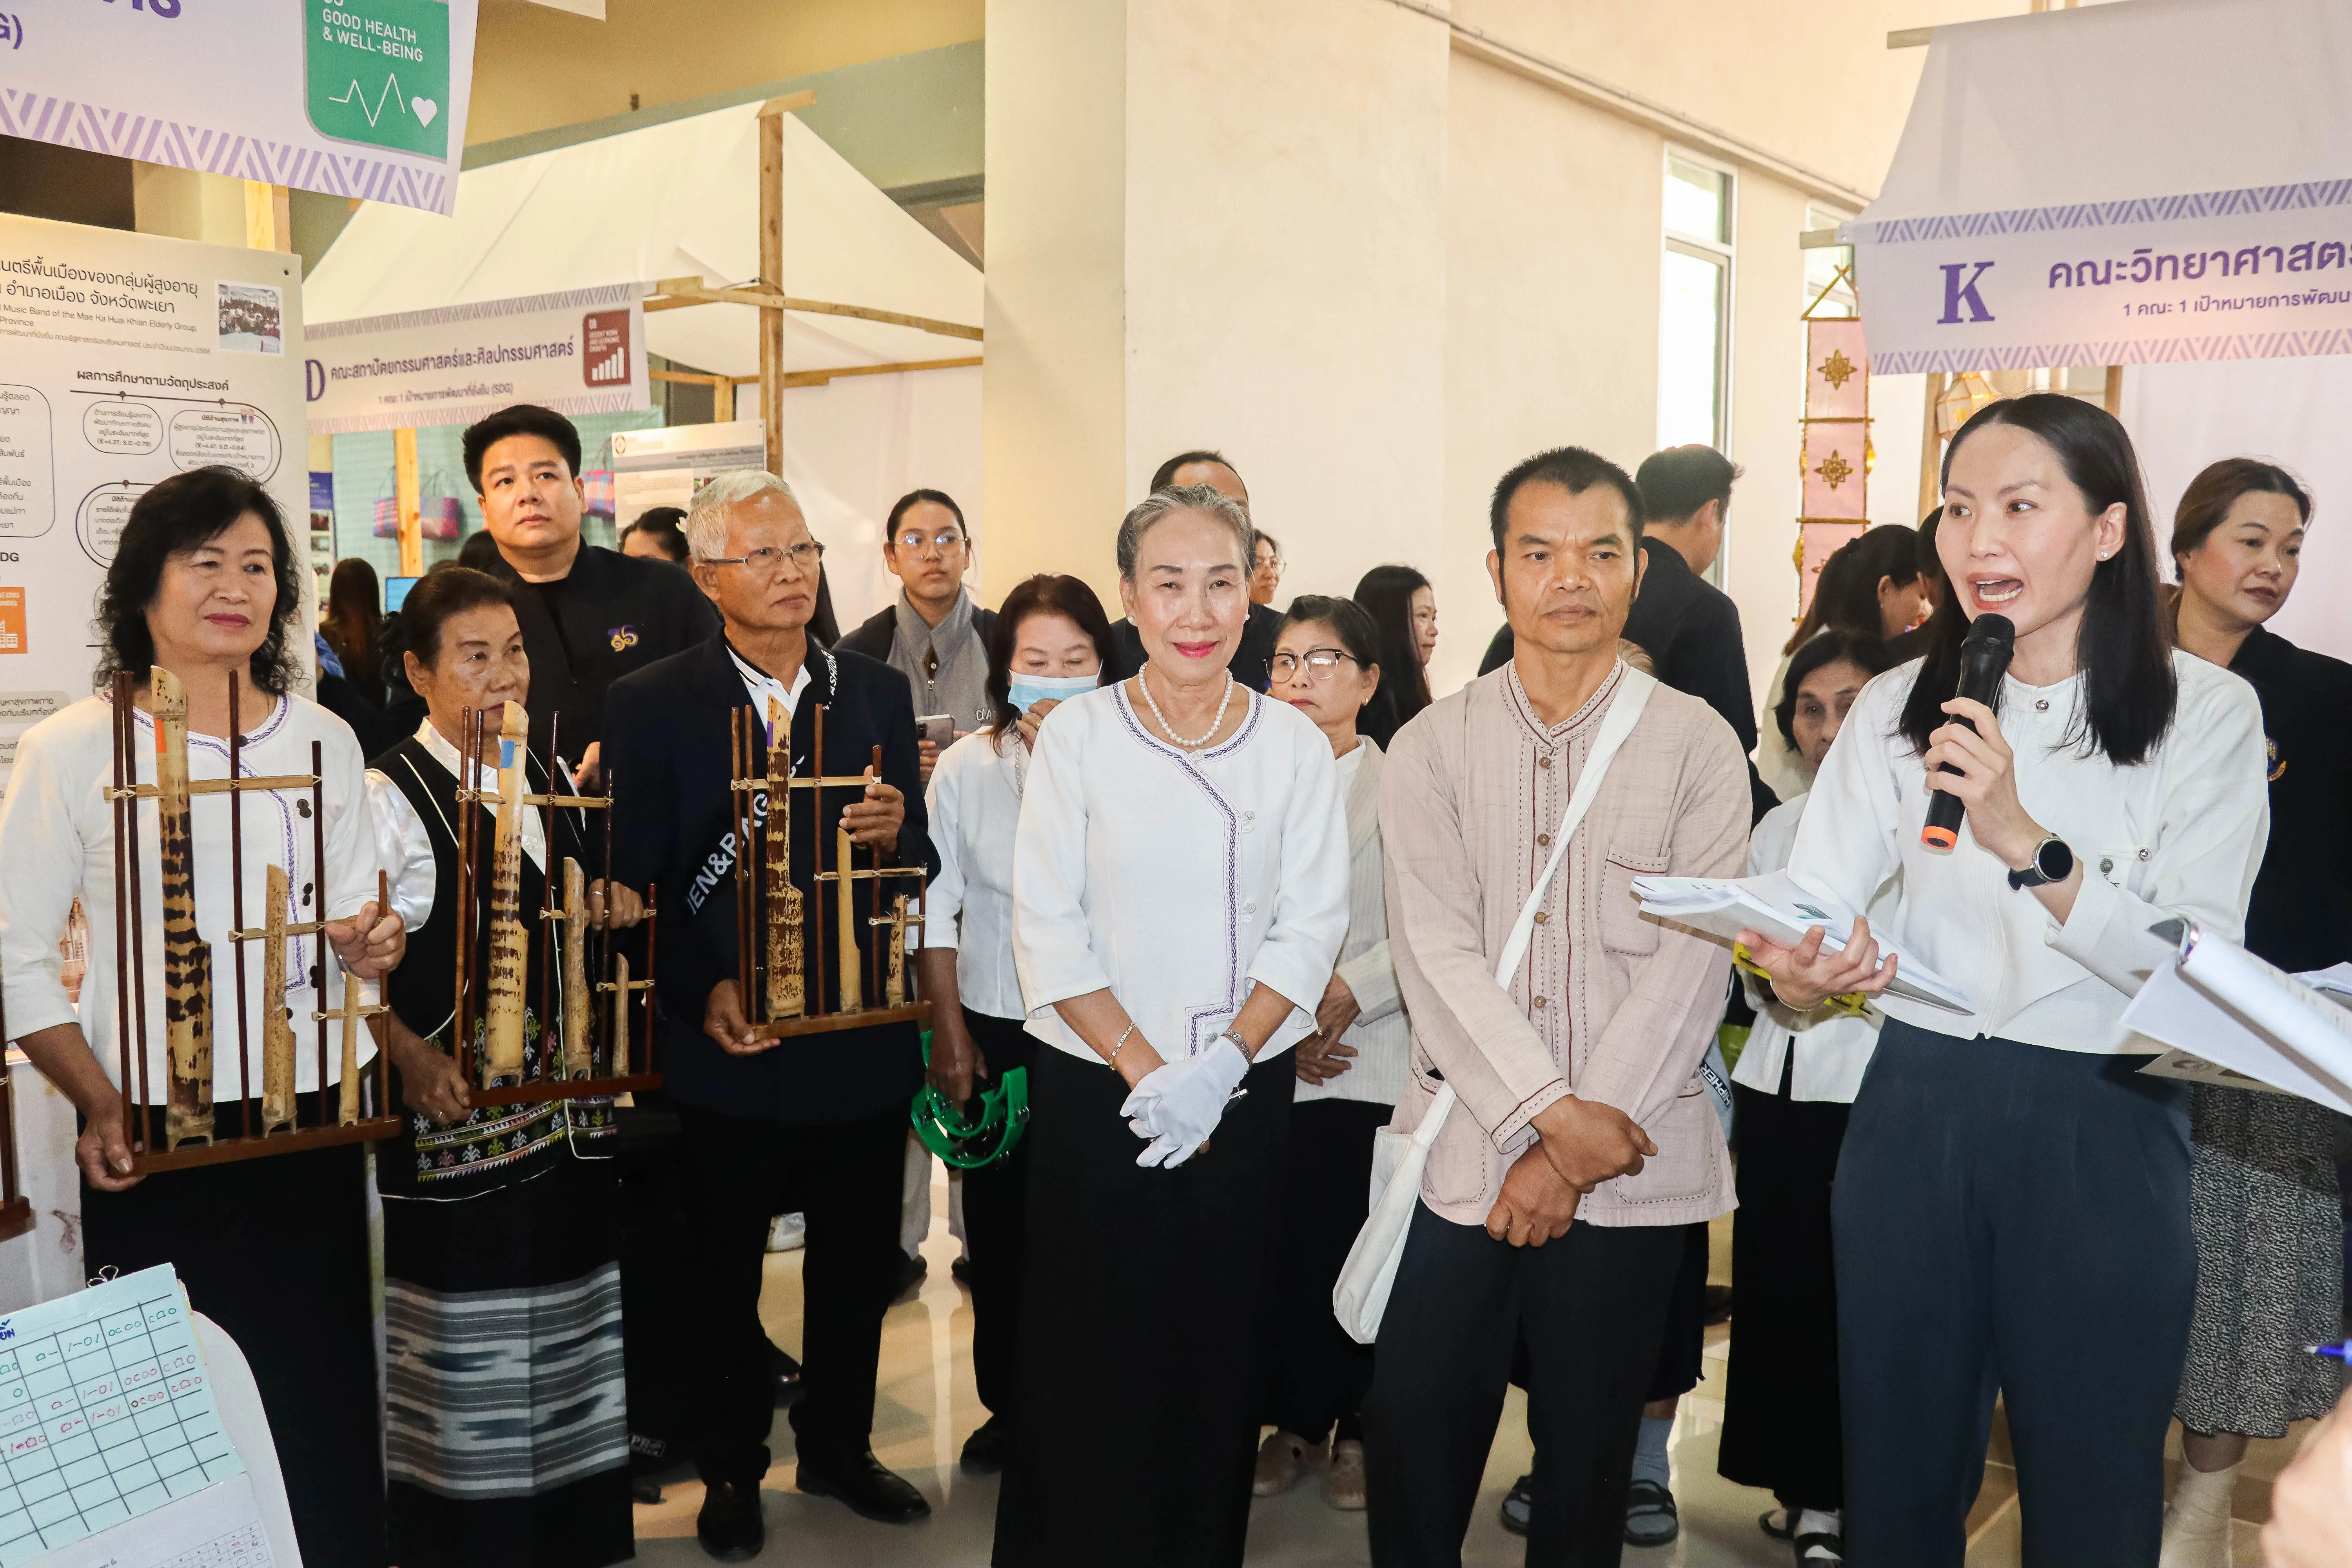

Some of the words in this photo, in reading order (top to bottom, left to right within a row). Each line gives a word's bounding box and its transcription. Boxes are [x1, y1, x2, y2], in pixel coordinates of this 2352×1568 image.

[322, 8, 361, 30] GOOD
[365, 19, 417, 44] HEALTH
[323, 26, 333, 42] &
[337, 29, 423, 63] WELL-BEING
[0, 256, 198, 299] นตรีพื้นเมืองของกลุ่มผู้สูงอายุ
[2049, 241, 2352, 288] คณะวิทยาศาสต
[7, 280, 85, 303] อำเภอเมือง
[91, 290, 174, 313] จังหวัดพะเยา
[1937, 261, 1995, 324] K
[2123, 303, 2130, 316] 1
[2138, 303, 2172, 316] คณะ
[2179, 300, 2187, 313] 1
[2194, 289, 2352, 312] เป้าหมายการพัฒน
[4, 304, 27, 314] Music
[30, 307, 50, 316] Band
[77, 312, 93, 321] Mae
[108, 316, 125, 324] Huai
[149, 319, 172, 330] Elderly
[77, 370, 229, 391] ผลการศึกษาตามวัตถุประสงค์
[305, 358, 325, 401] D
[976, 708, 996, 721] CLA
[1700, 1063, 1731, 1105] HIPHER
